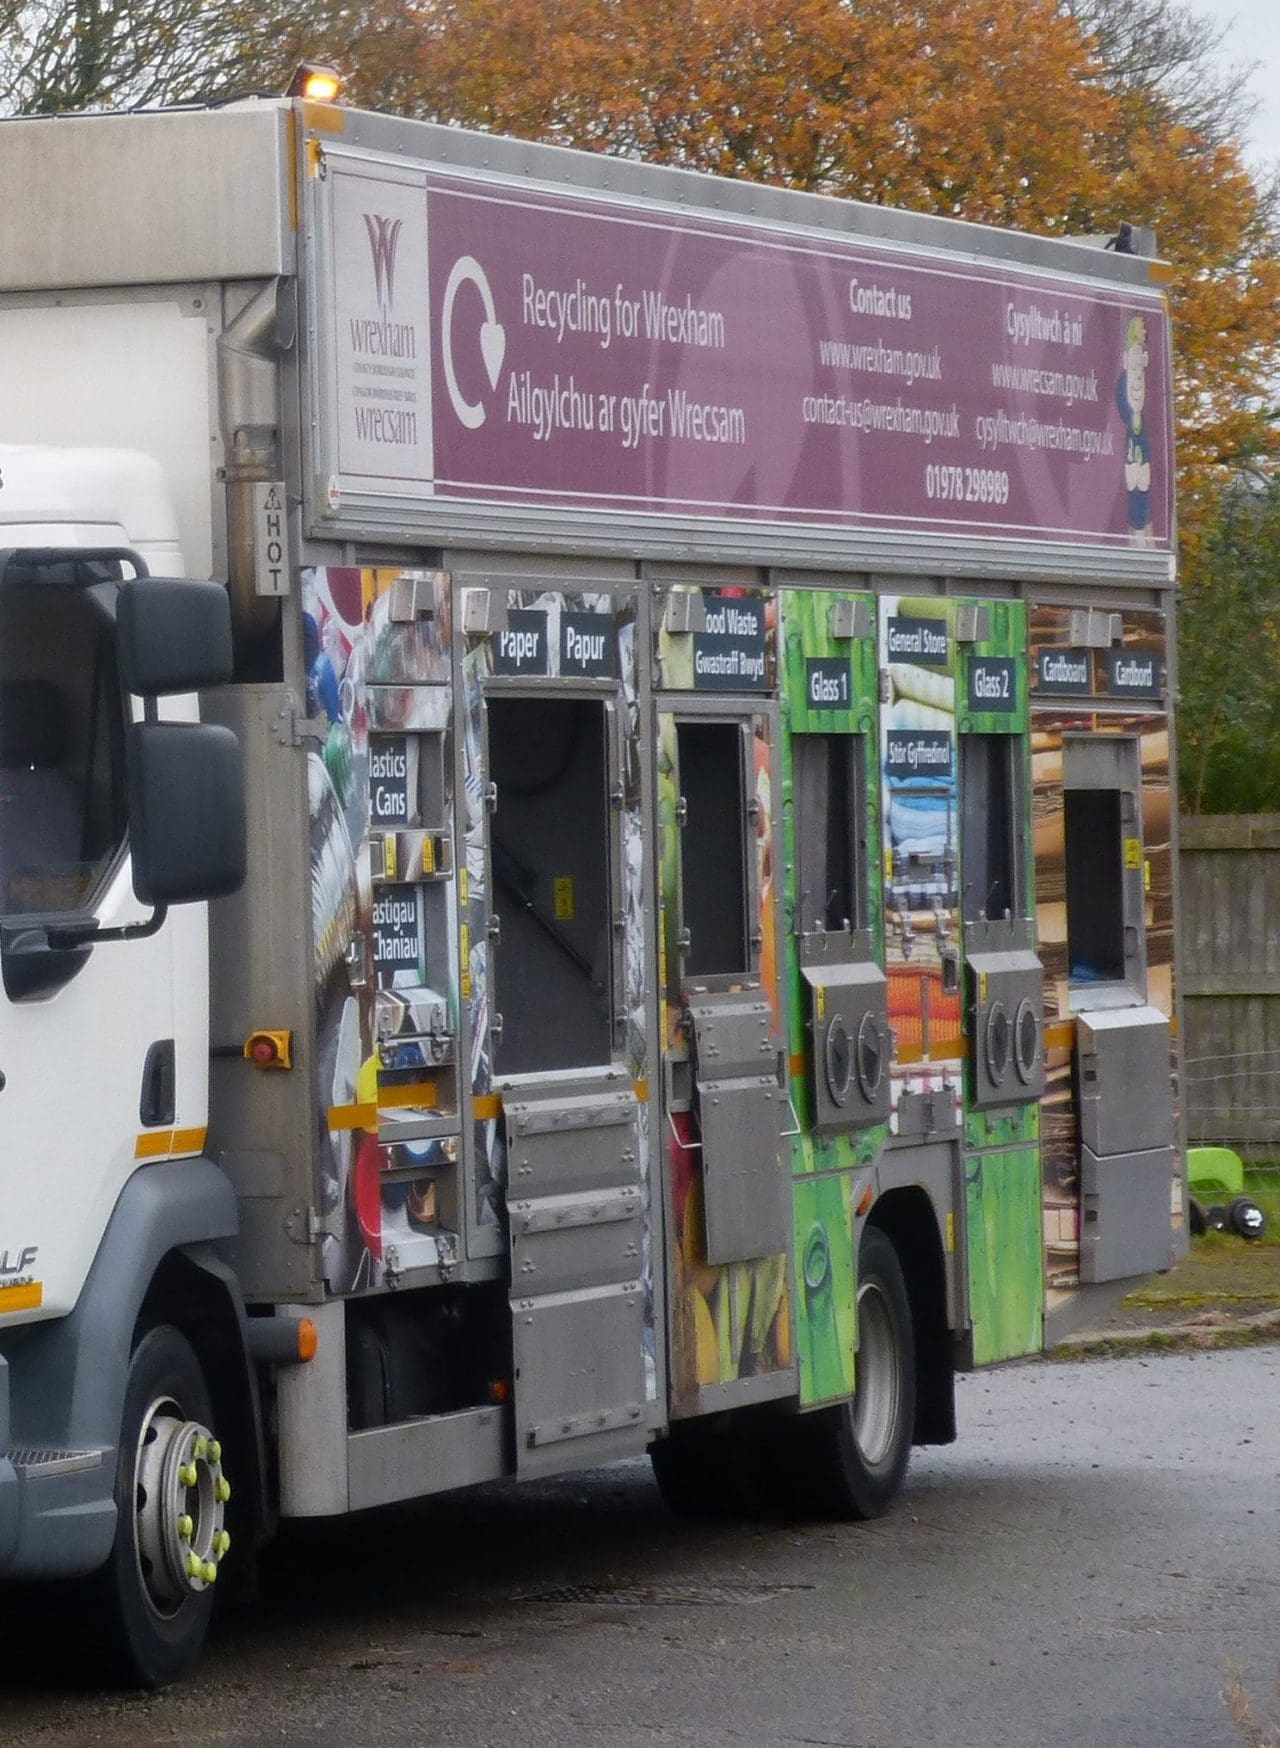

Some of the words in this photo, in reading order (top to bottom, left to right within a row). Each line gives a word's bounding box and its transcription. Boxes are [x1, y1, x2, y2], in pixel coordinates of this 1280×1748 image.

[522, 273, 611, 349] Recycling
[615, 283, 641, 338] for
[643, 290, 725, 348] Wrexham
[849, 278, 897, 318] Contact
[897, 293, 912, 320] us
[820, 337, 942, 386] www.wrexham.gov.uk
[991, 363, 1099, 407] www.wrecsam.gov.uk
[507, 370, 594, 442] Ailgylchu
[598, 394, 617, 432] ar
[620, 382, 666, 449] gyfer
[668, 388, 745, 444] Wrecsam
[802, 393, 960, 444] contact-us@wrexham.gov.uk
[926, 464, 964, 501] 01978
[965, 467, 1009, 505] 298989
[267, 513, 282, 592] HOT
[703, 605, 726, 634] ood
[726, 608, 758, 636] Waste
[566, 626, 605, 669] Papur
[888, 627, 922, 653] General
[923, 629, 947, 654] Store
[695, 649, 739, 675] Gwastraff
[739, 651, 764, 682] Bwyd
[975, 667, 1000, 698] Glass
[1001, 669, 1009, 698] 2
[1043, 655, 1087, 683] Cardboard
[810, 670, 839, 702] Glass
[840, 672, 847, 701] 1
[369, 746, 406, 778] lastics
[376, 786, 406, 816] Cans
[372, 894, 415, 931] astigau
[0, 1246, 38, 1275] LF
